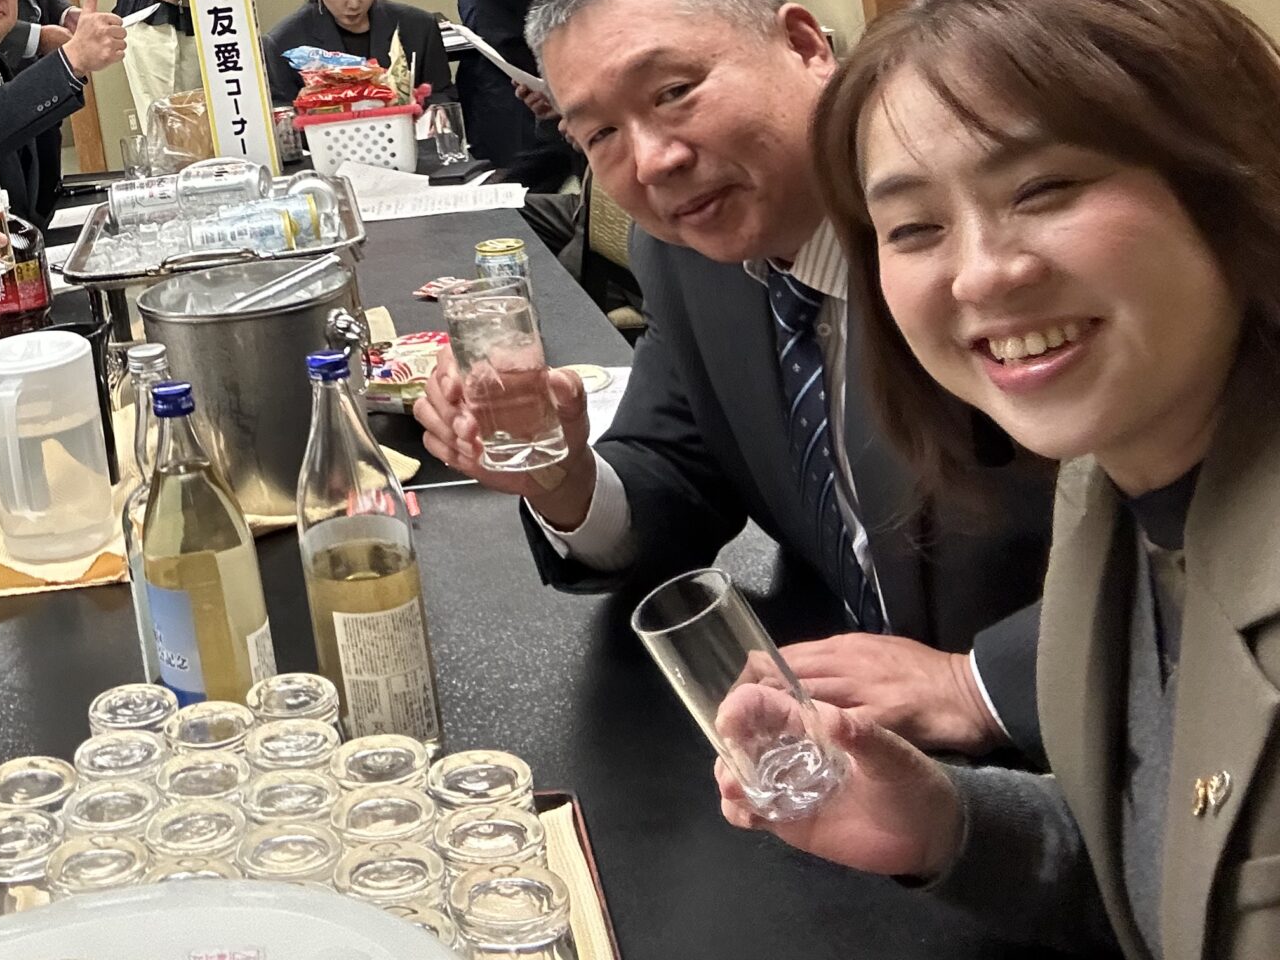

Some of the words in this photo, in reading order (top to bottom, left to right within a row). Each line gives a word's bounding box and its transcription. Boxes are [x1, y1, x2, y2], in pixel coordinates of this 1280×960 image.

[207, 6, 247, 155] 友愛コーナー
